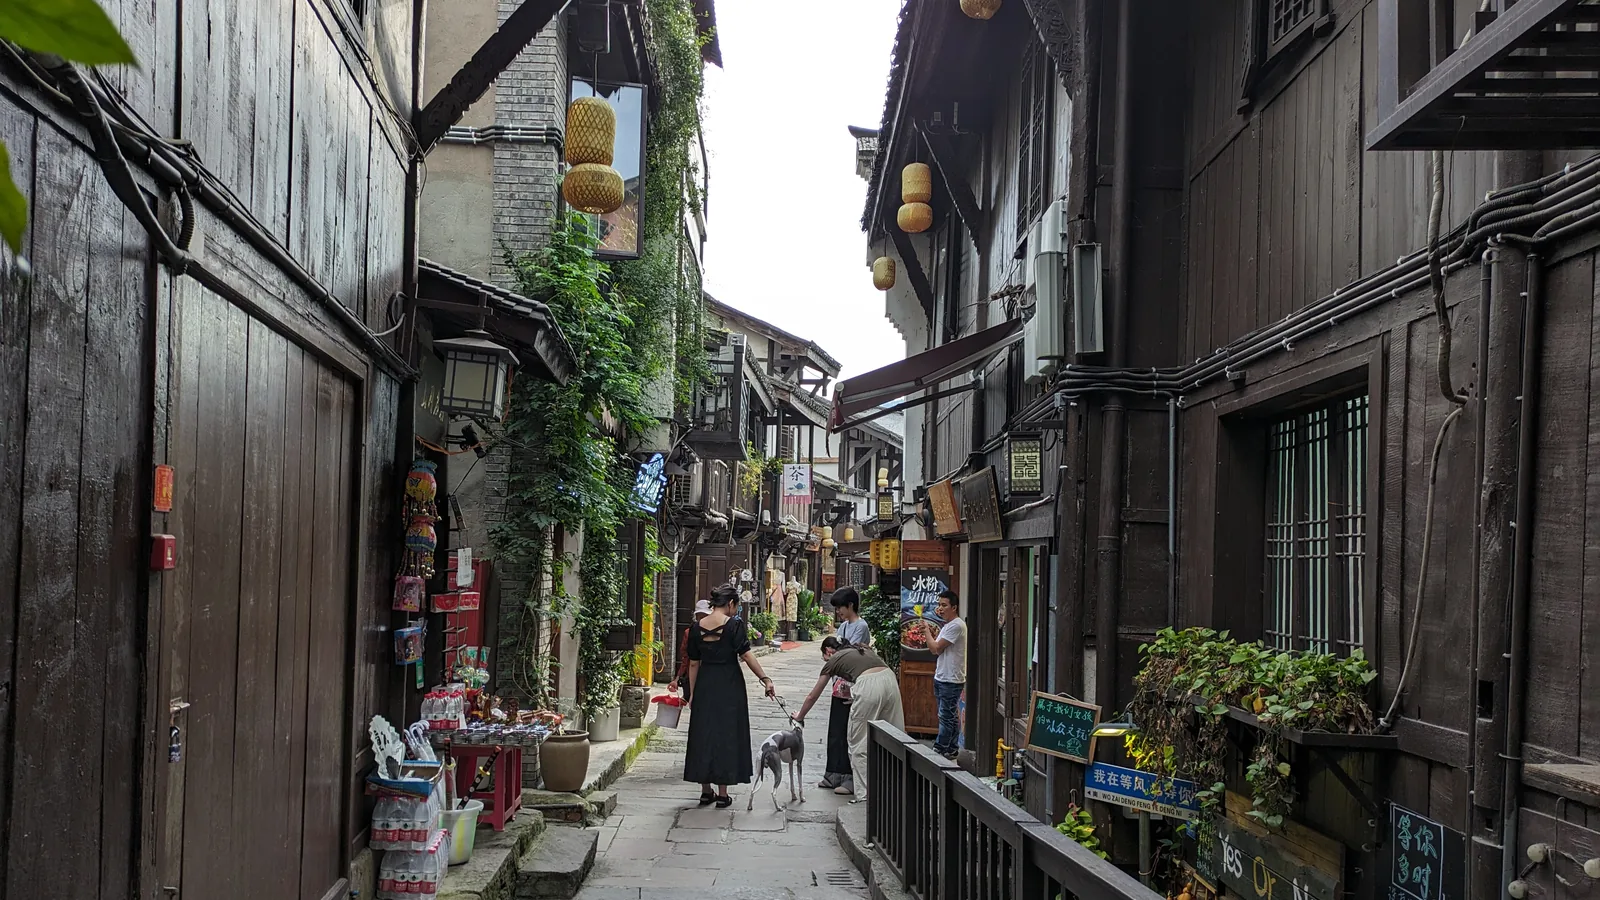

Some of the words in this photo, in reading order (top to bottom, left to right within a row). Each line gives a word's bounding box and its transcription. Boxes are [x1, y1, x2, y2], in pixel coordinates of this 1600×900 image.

[789, 466, 804, 481] 茶
[912, 574, 938, 592] 冰粉
[1036, 699, 1094, 723] 属于我们女孩
[1102, 793, 1111, 801] WO
[1112, 795, 1120, 803] ZAI
[1121, 797, 1136, 806] DENG
[1137, 801, 1151, 810] FENG
[1160, 806, 1175, 815] DENG
[1397, 814, 1438, 859] 等你
[1219, 831, 1243, 878] Yes
[1397, 853, 1432, 900] 多时
